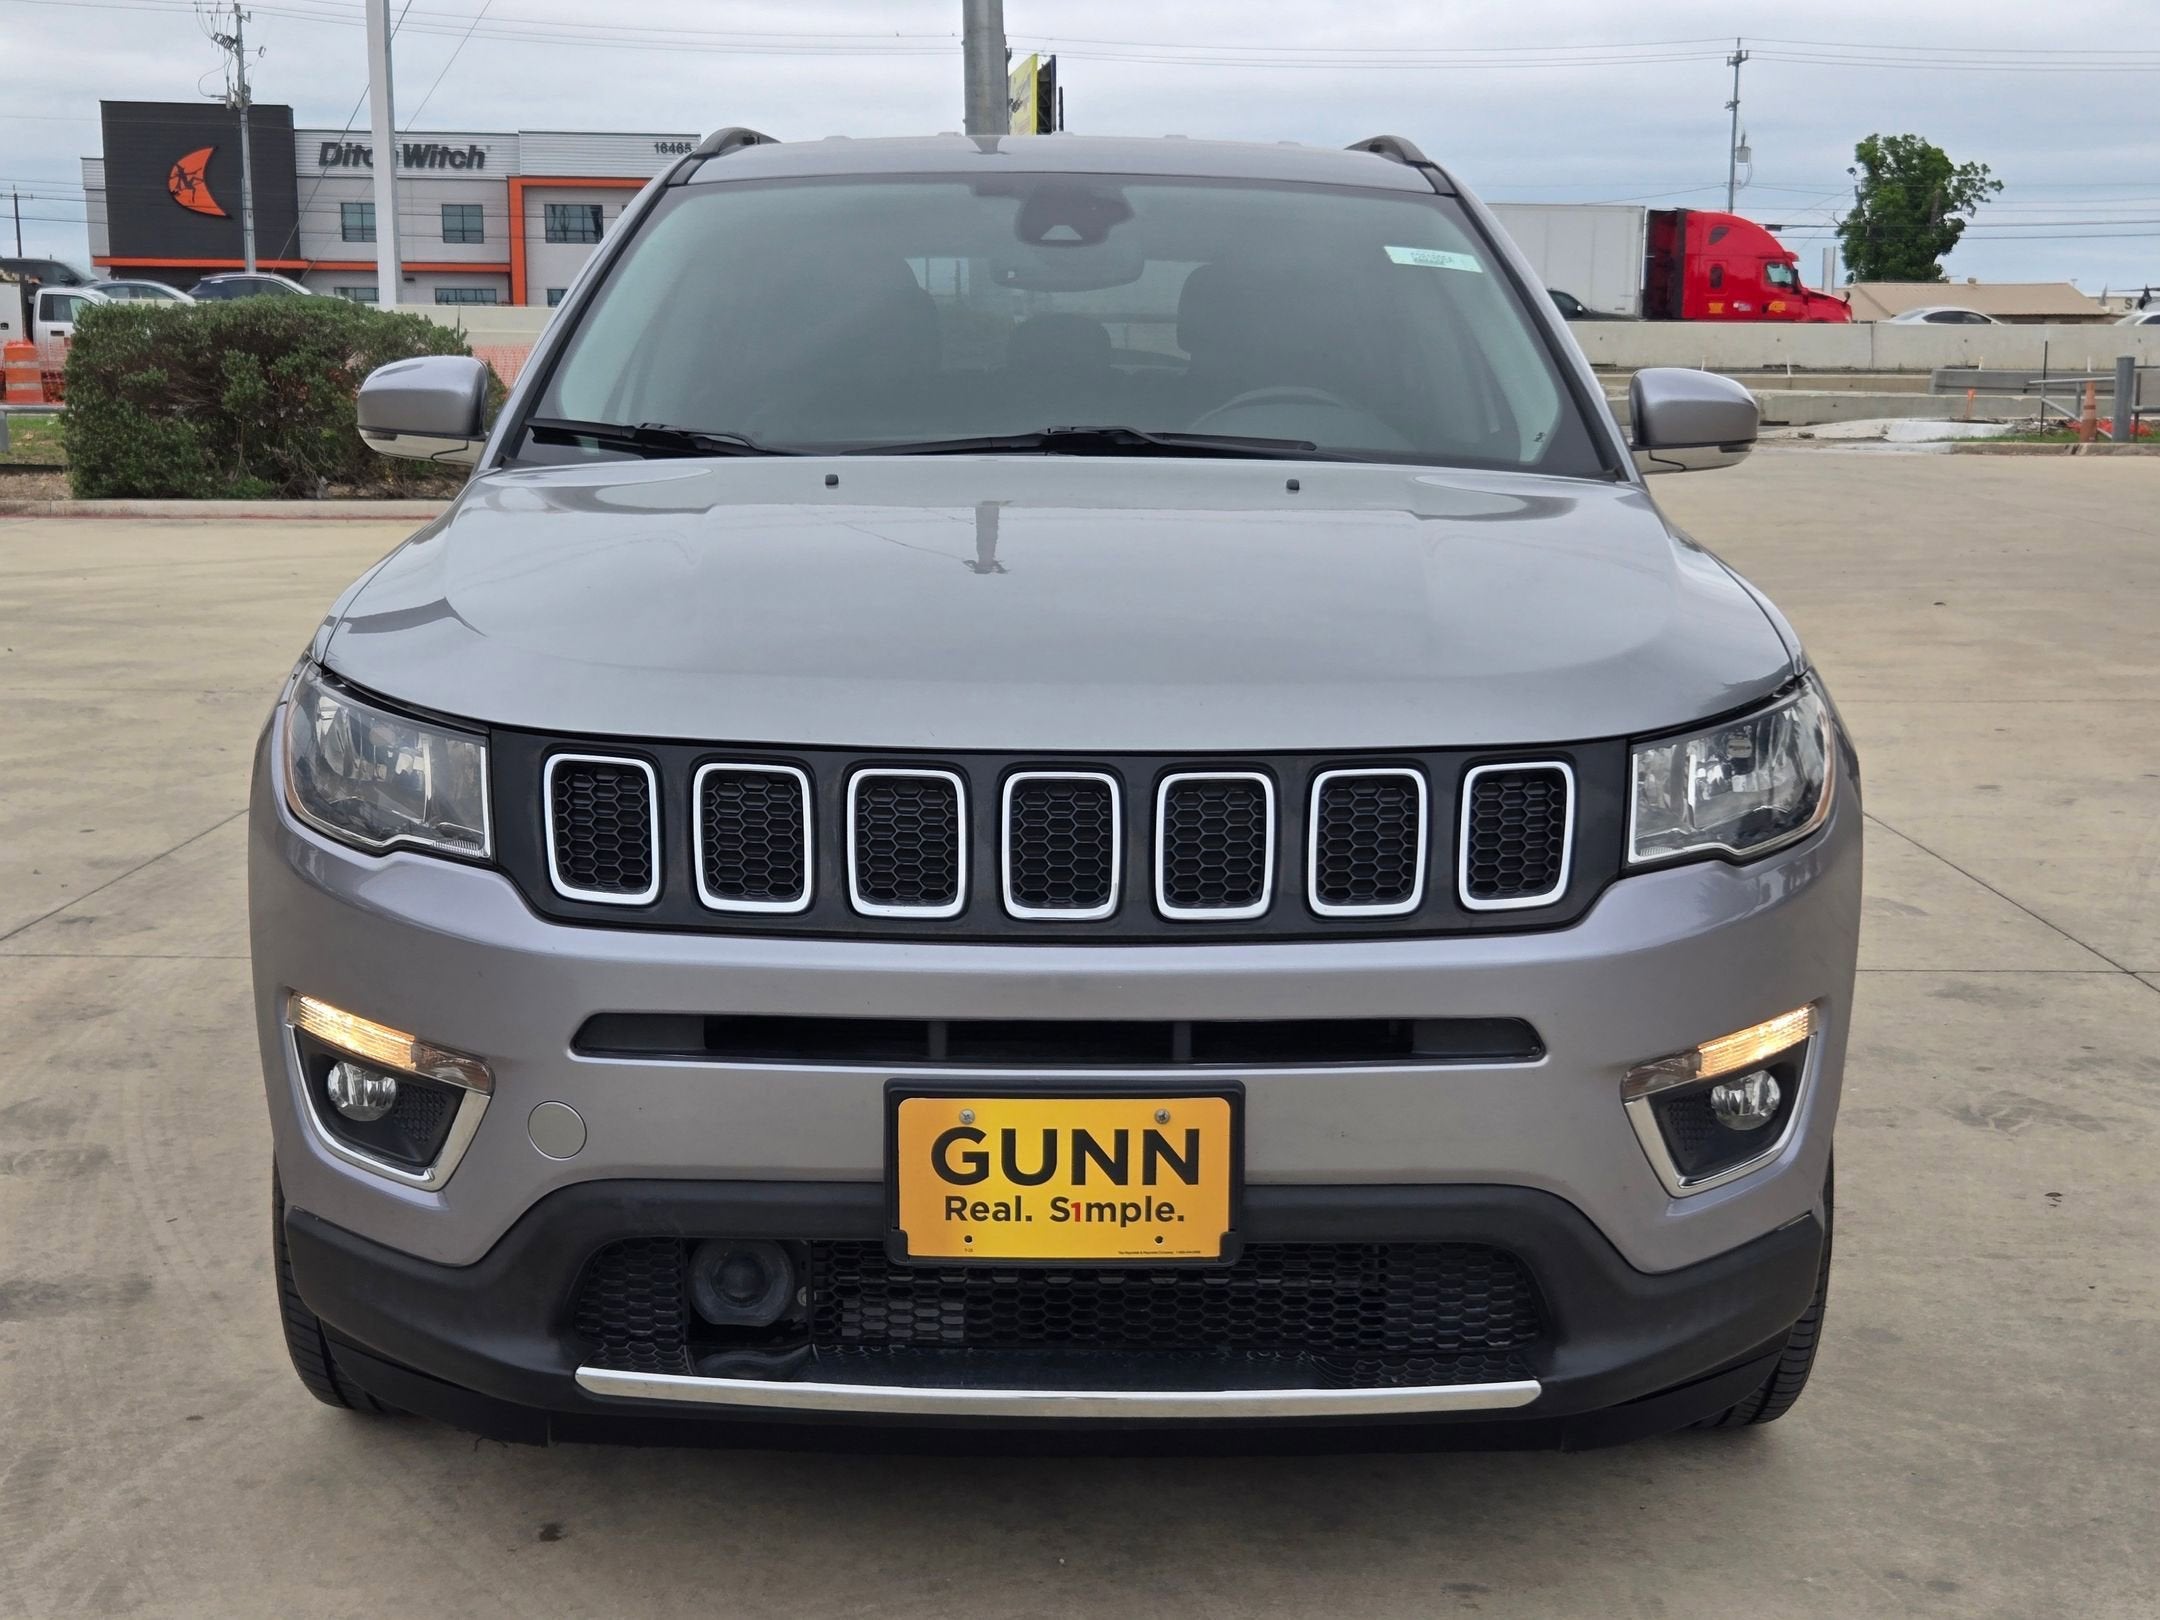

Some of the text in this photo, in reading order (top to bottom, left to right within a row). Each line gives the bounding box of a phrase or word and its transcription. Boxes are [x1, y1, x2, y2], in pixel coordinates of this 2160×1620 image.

[319, 142, 486, 169] Ditc Witch
[931, 1126, 1200, 1187] GUNN
[945, 1195, 1033, 1222] Real.
